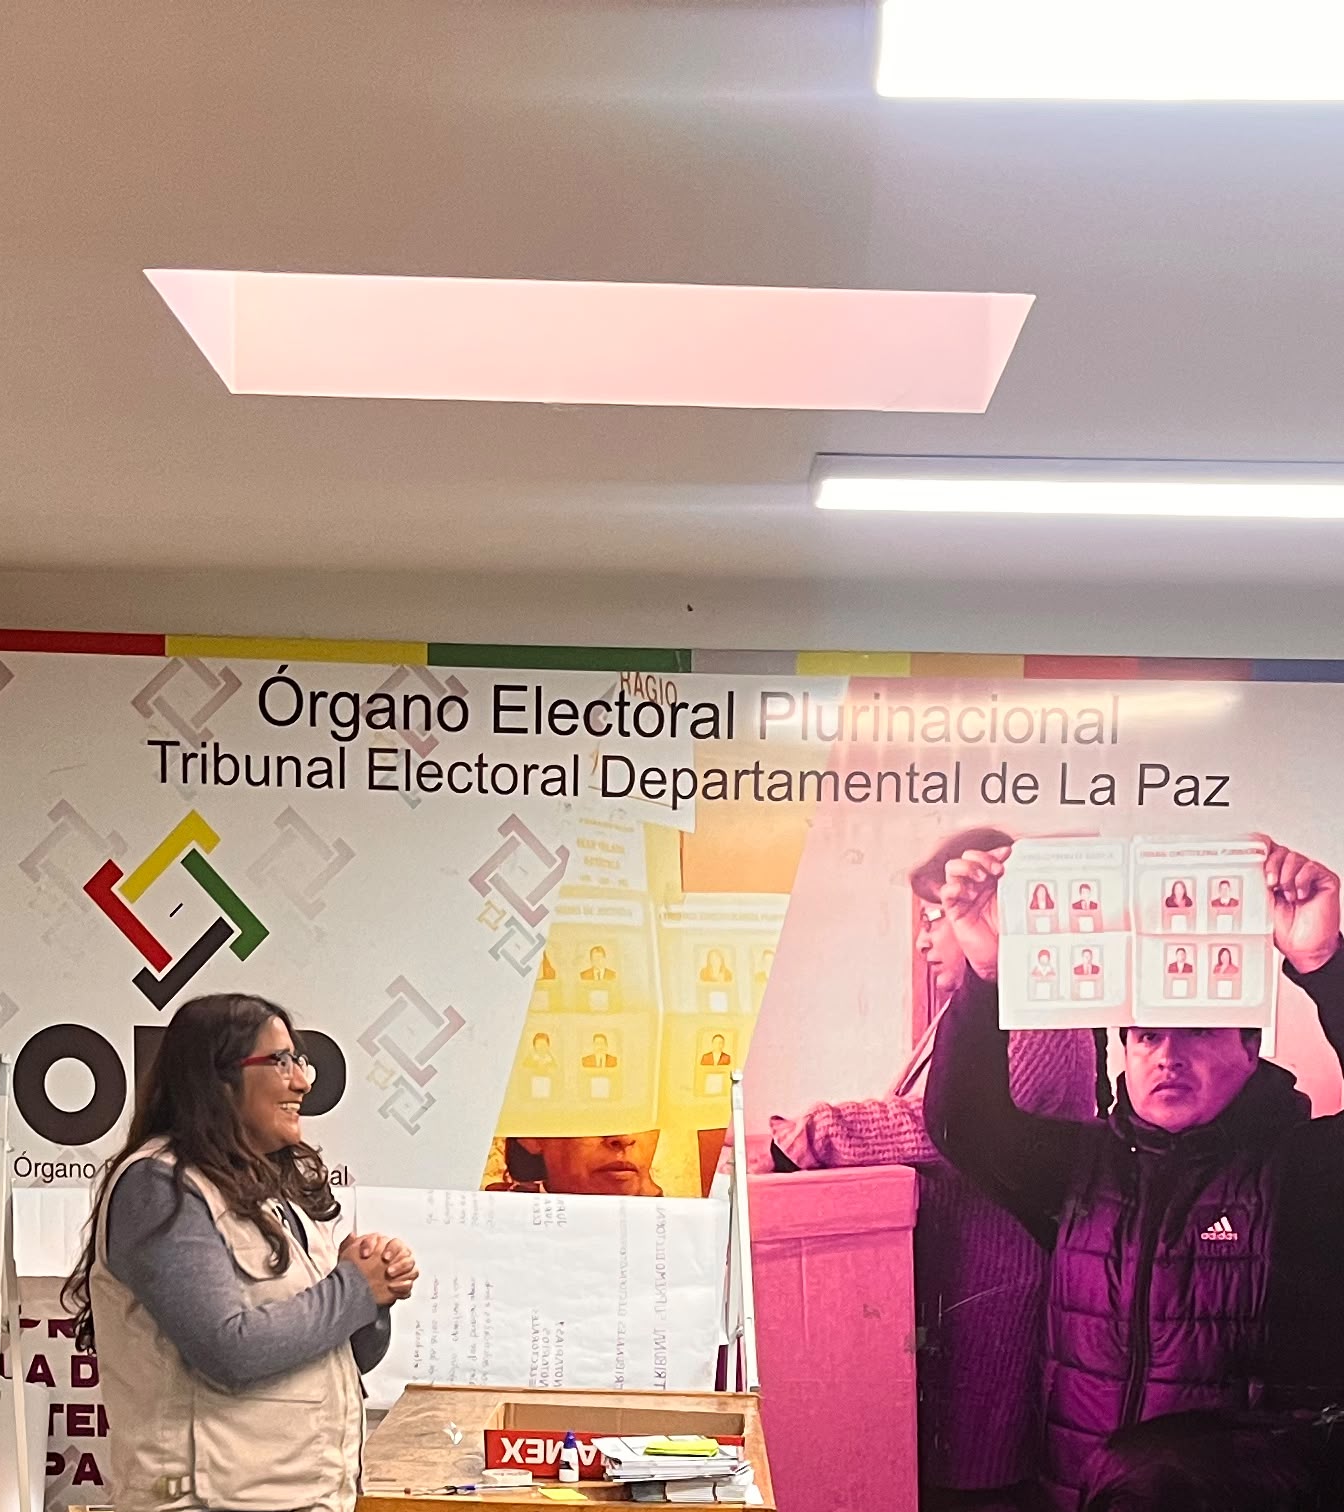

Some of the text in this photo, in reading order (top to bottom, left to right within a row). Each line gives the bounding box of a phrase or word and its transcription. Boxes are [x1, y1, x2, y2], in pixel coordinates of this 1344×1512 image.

[258, 664, 1120, 746] Órgano Electoral Plurinacional
[147, 739, 1232, 811] Tribunal Electoral Departamental de La Paz
[13, 1023, 347, 1146] OP
[13, 1151, 96, 1182] Órgano
